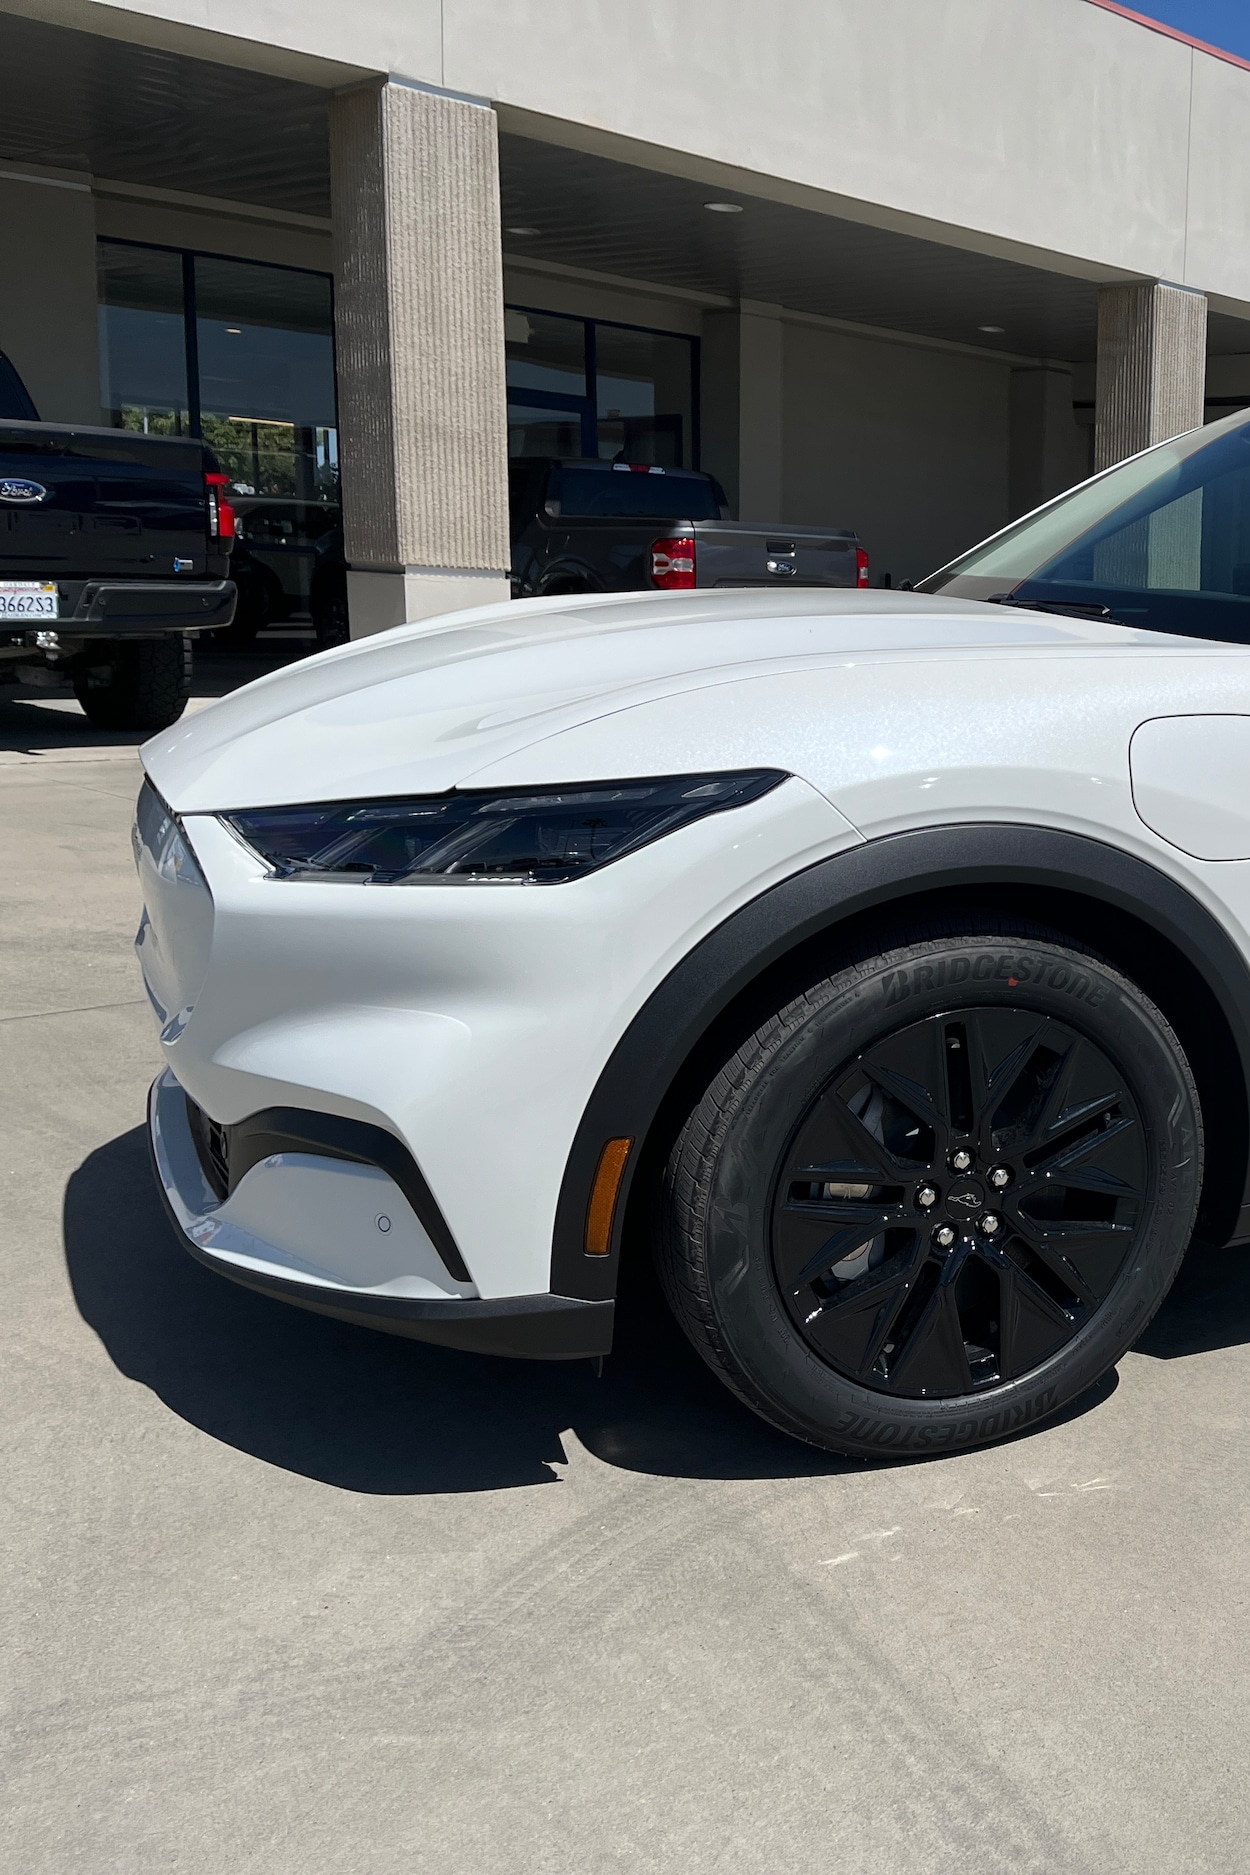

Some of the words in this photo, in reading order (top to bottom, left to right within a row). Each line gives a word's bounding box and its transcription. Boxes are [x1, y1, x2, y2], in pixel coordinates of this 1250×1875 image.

[1, 482, 33, 497] Ford
[881, 954, 1111, 1009] BRIDGESTONE
[830, 1385, 1060, 1448] BRIDGESTONE
